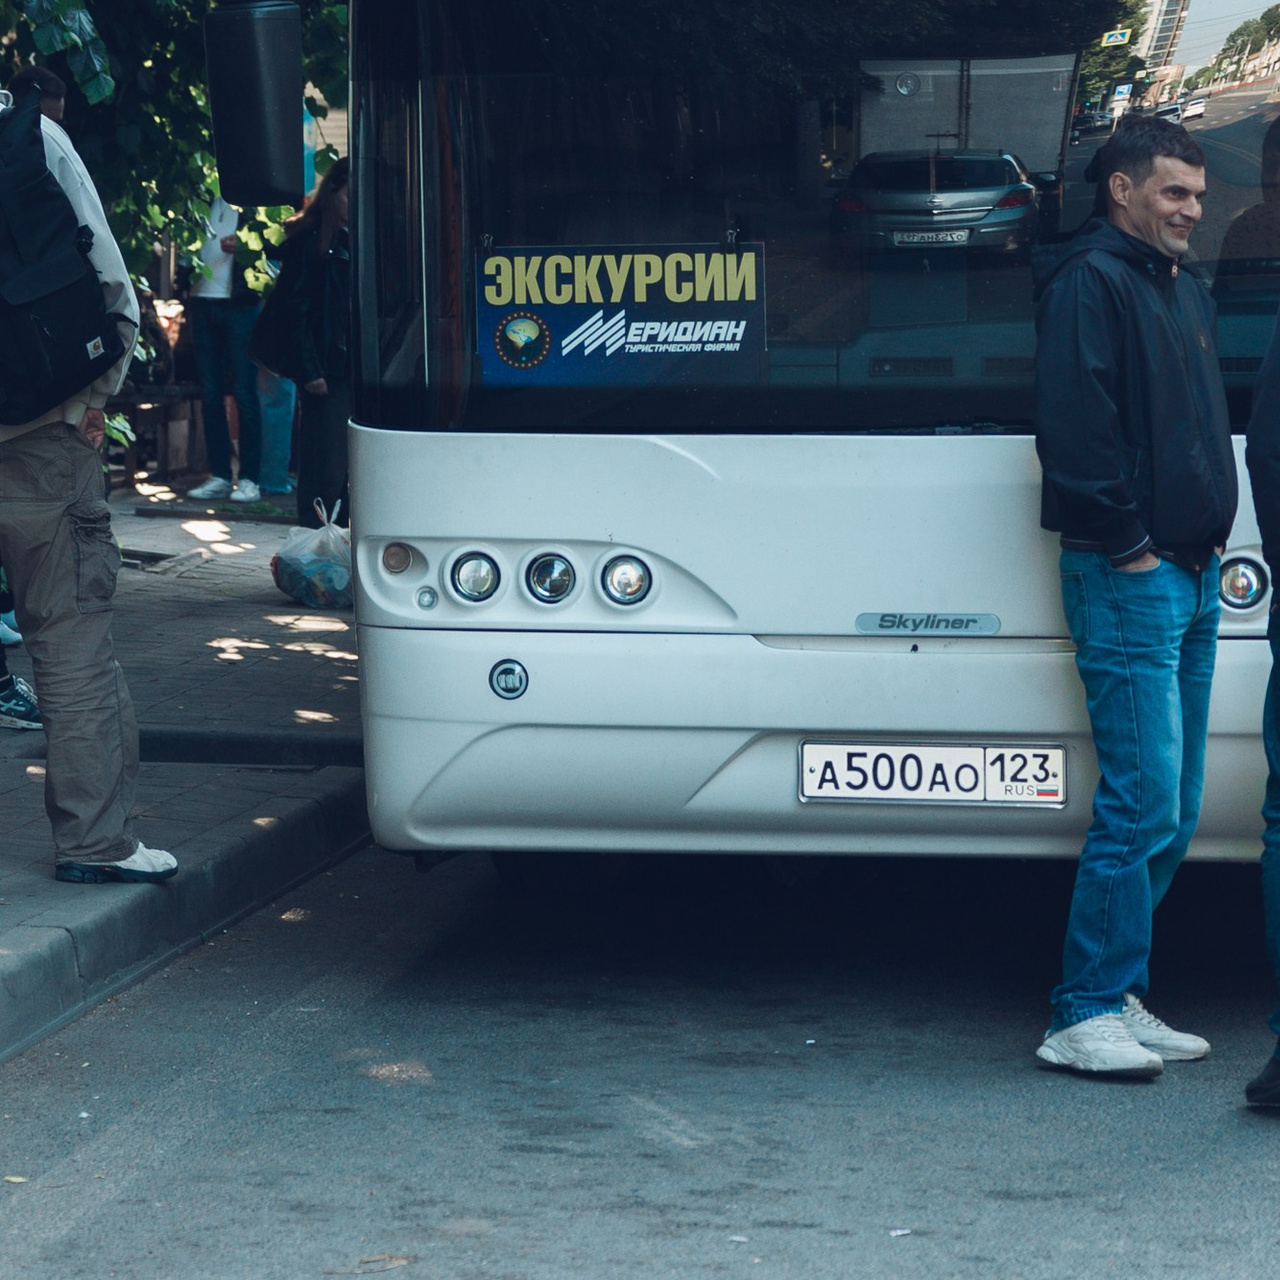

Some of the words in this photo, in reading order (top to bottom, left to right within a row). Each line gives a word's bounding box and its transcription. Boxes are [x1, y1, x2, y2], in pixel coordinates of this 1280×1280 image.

[484, 252, 756, 306] ЭКСКУРСИИ
[624, 343, 702, 354] ТУРИСТИЧЕСКАЯ
[704, 342, 740, 352] ФИРМА
[878, 613, 978, 632] Skyliner
[817, 752, 979, 792] А500АО
[989, 753, 1050, 783] 123
[1004, 785, 1035, 796] RUS
